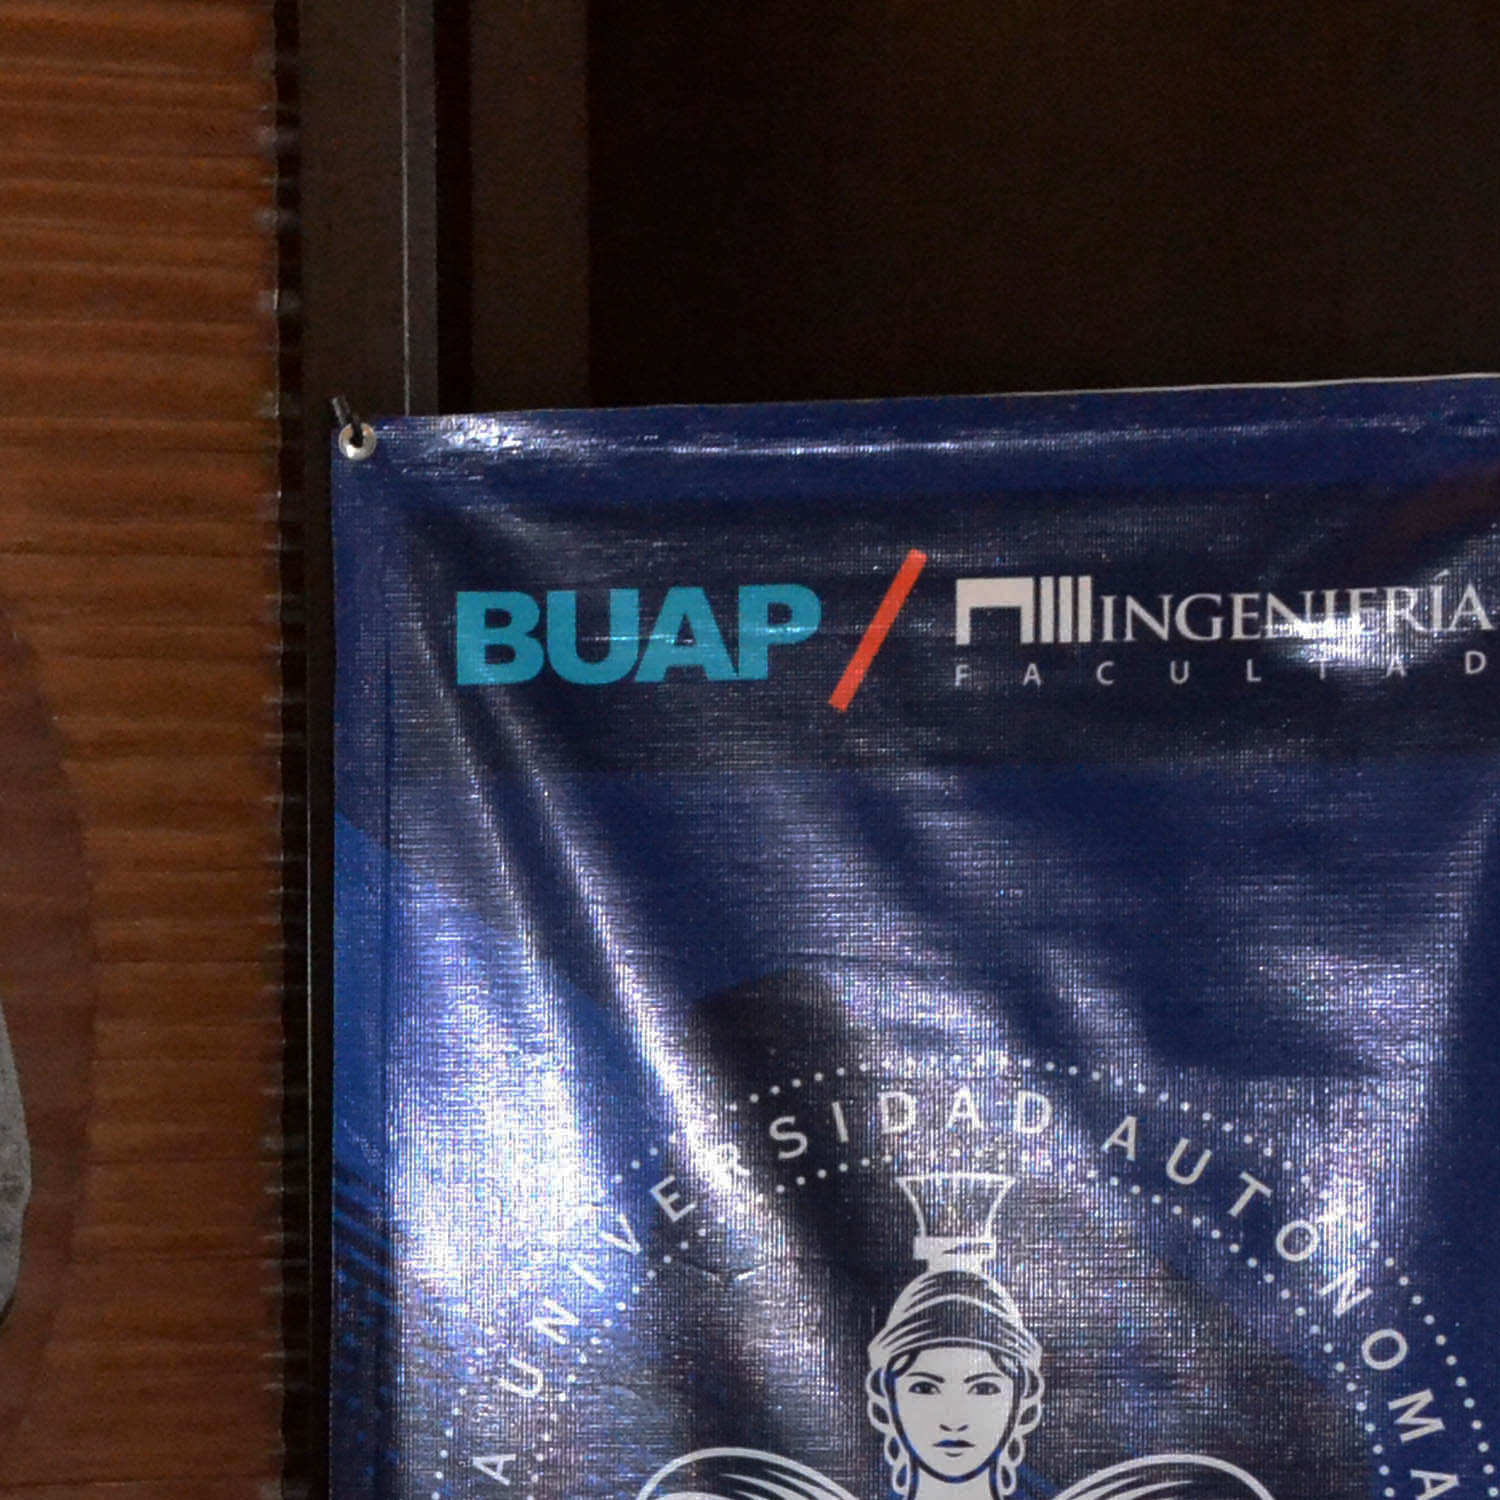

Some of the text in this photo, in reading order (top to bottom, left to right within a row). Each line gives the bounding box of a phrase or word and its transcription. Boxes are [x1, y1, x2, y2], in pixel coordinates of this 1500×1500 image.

[456, 569, 1496, 686] BUAP INGENIERÍA
[955, 651, 1487, 686] FACULTAD
